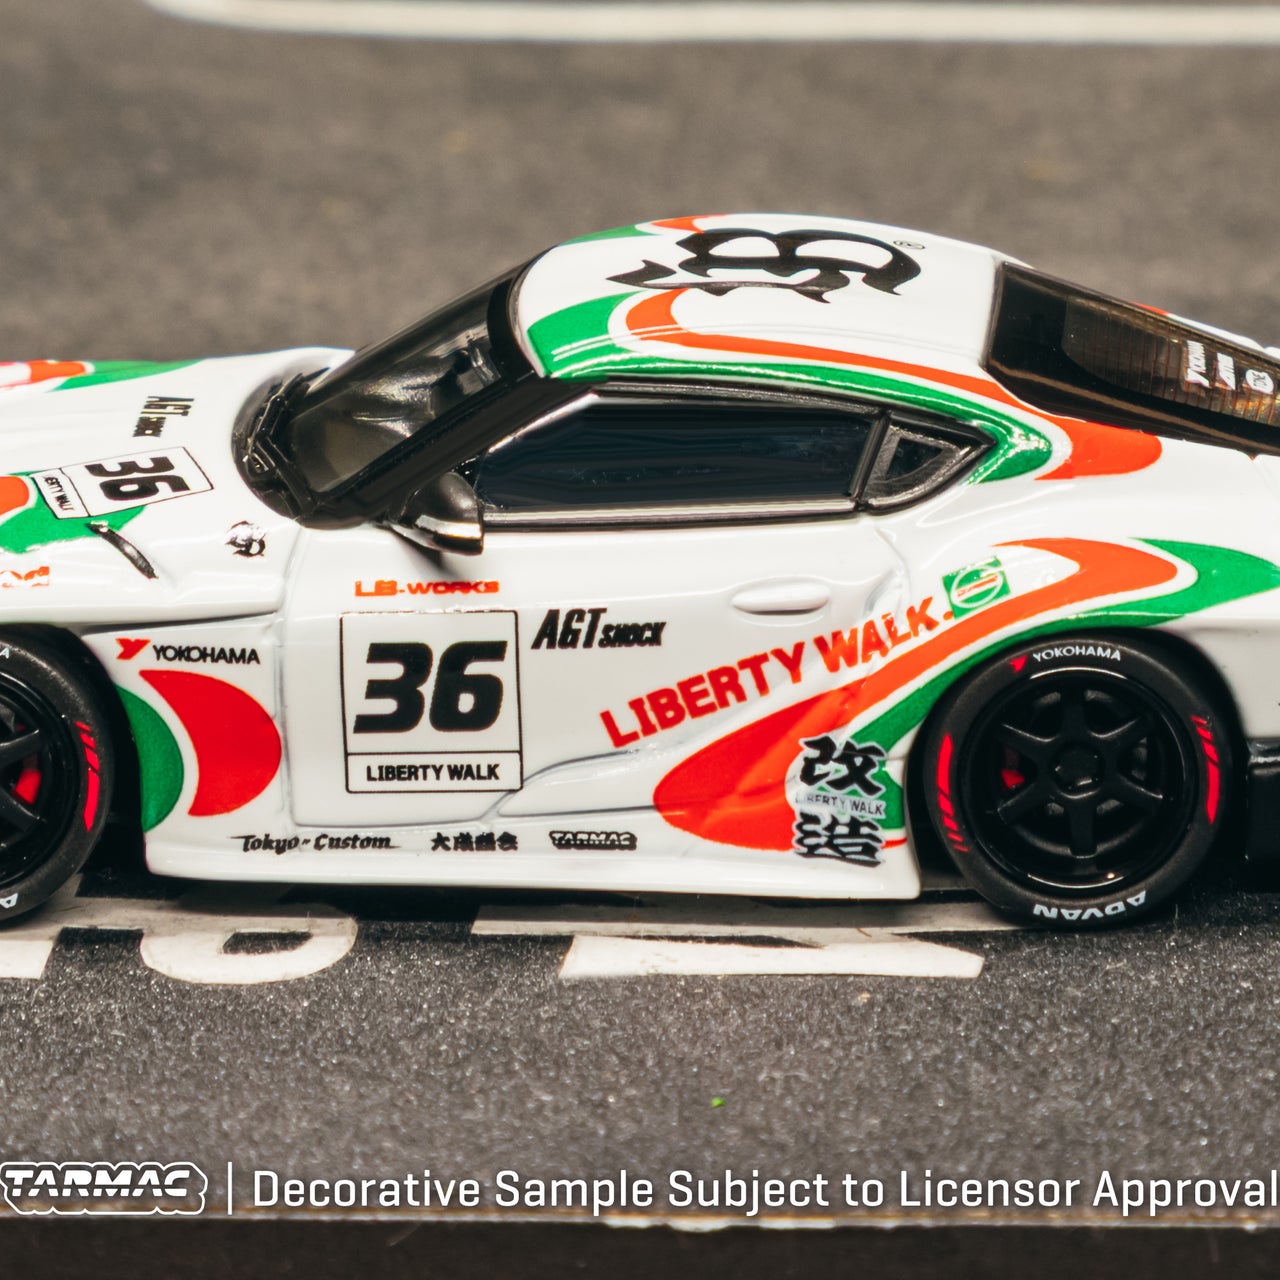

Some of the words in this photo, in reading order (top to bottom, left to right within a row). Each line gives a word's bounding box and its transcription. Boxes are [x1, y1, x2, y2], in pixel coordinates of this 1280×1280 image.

[84, 456, 191, 502] 36
[152, 644, 262, 665] YOKOHAMA
[1032, 645, 1122, 662] YOKOHAMA
[353, 640, 508, 734] 36
[600, 641, 806, 749] LIBERTY
[366, 763, 444, 782] LIBERTY
[447, 763, 500, 781] WALK
[1032, 889, 1147, 920] ADVAN
